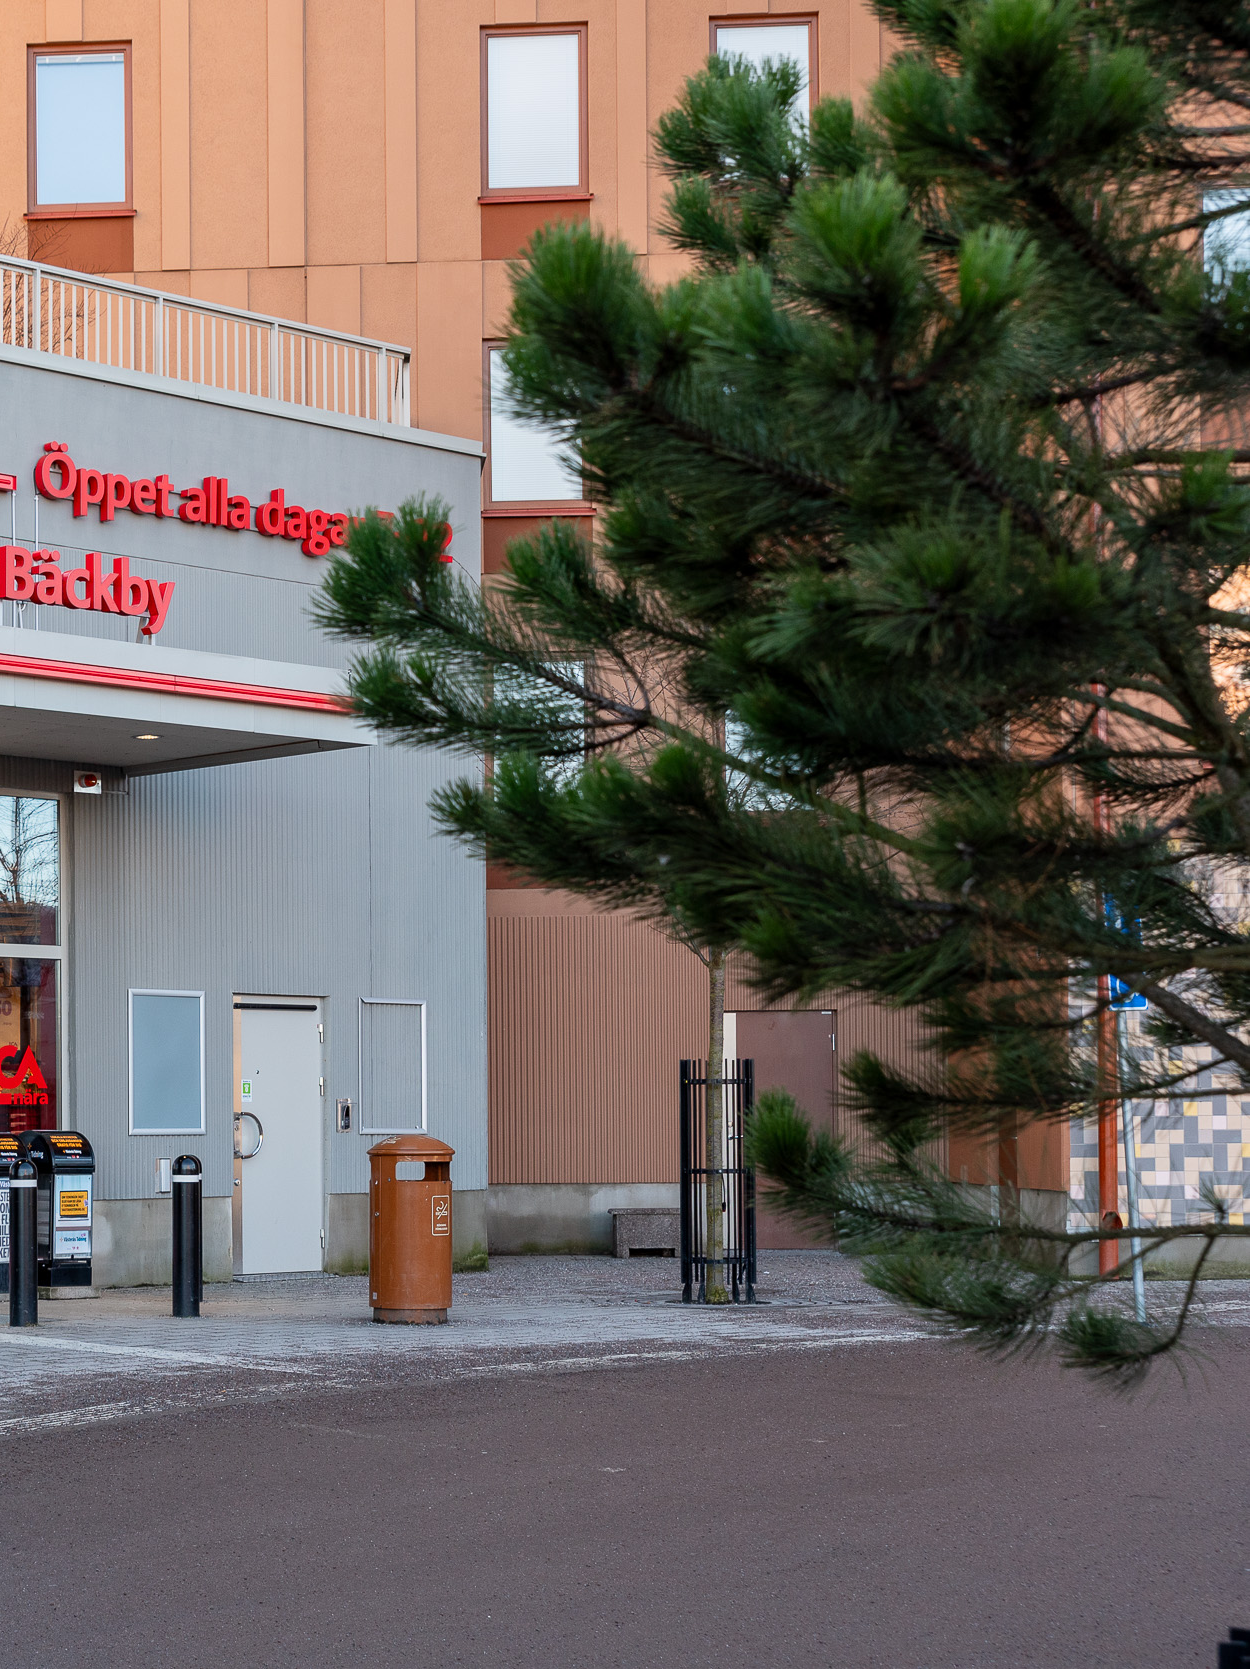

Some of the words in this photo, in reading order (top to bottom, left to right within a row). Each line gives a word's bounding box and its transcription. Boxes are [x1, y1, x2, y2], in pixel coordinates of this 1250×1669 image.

[34, 440, 175, 522] Öppet
[179, 476, 251, 530] alla
[12, 1090, 49, 1105] nära
